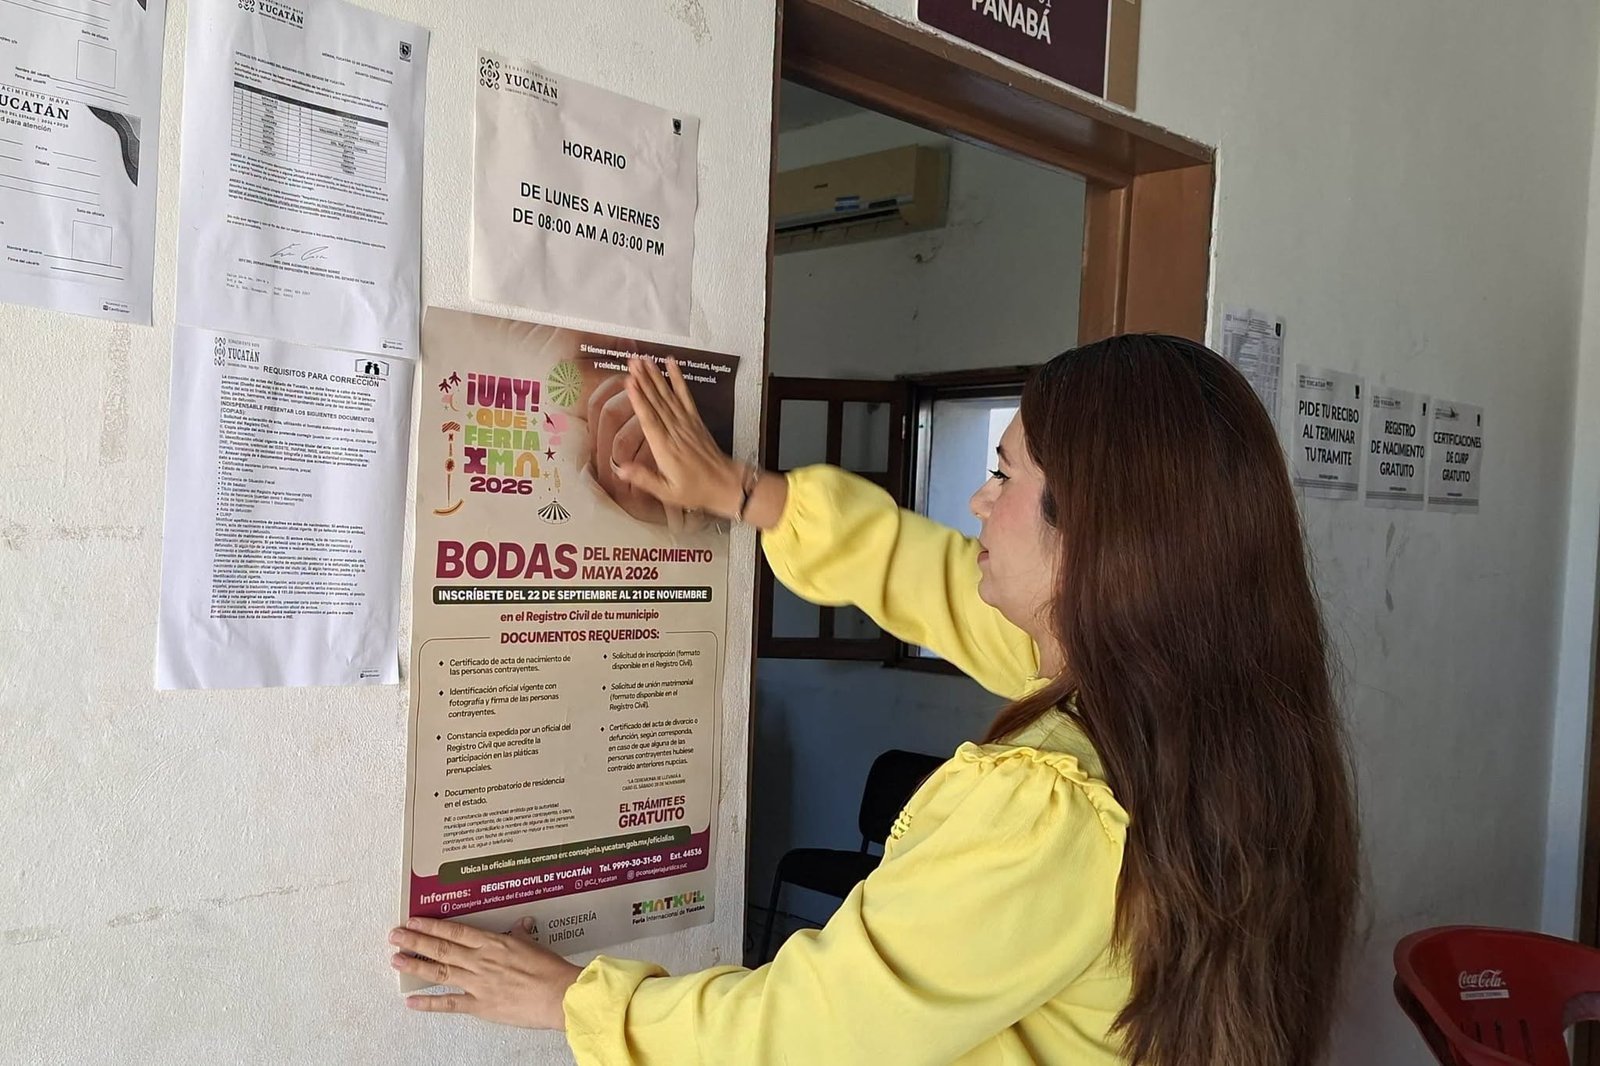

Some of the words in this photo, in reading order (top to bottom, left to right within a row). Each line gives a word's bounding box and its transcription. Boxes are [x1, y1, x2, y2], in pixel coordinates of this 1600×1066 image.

[259, 2, 303, 24] YUCATÁN
[505, 73, 557, 99] YUCATÁN
[562, 140, 626, 170] HORARIO
[521, 182, 541, 200] DE
[545, 188, 589, 212] LUNES
[594, 202, 603, 216] A
[607, 204, 660, 230] VIERNES
[513, 207, 533, 226] DE
[538, 214, 571, 234] 08:00
[575, 223, 596, 240] AM
[600, 228, 609, 243] A
[612, 231, 642, 251] 03:00
[646, 240, 664, 256] PM
[228, 347, 260, 362] YUCATÁN
[588, 345, 606, 354] tienes
[607, 349, 631, 358] mayoría
[599, 362, 620, 370] celebra
[263, 365, 306, 379] REQUISITOS
[308, 371, 328, 381] PARA
[330, 374, 380, 388] CORRECCIÓN
[466, 372, 540, 413] ¡UAY!
[221, 401, 263, 410] INDISPENSABLE
[264, 405, 294, 414] PRESENTAR
[307, 411, 337, 419] SIGUIENTES
[338, 414, 375, 423] DOCUMENTOS
[1299, 400, 1320, 417] PIDE
[1322, 403, 1330, 418] TU
[1331, 406, 1359, 423] RECIBO
[1302, 424, 1314, 439] AL
[1316, 426, 1355, 444] TERMINAR
[1385, 420, 1416, 437] REGISTRO
[464, 425, 540, 451] FERIA
[1433, 432, 1481, 448] CERTIFICACIONES
[1305, 447, 1316, 462] TU
[1318, 448, 1352, 466] TRAMITE
[1371, 440, 1381, 454] DE
[1383, 441, 1424, 459] NACIMIENTO
[1446, 452, 1454, 463] DE
[1454, 452, 1469, 464] CURP
[1380, 462, 1414, 477] GRATUITO
[1442, 469, 1470, 482] GRATUITO
[470, 476, 533, 495] 2026
[436, 540, 577, 579] BODAS
[584, 547, 608, 561] DEL
[612, 548, 712, 562] RENACIMIENTO
[582, 566, 622, 579] MAYA
[625, 566, 658, 579] 2026
[439, 588, 503, 600] INSCRÍBETE
[505, 590, 524, 600] DEL
[527, 590, 539, 600] 22
[541, 590, 555, 599] DE
[557, 590, 617, 599] SEPTIEMBRE
[619, 590, 629, 599] AL
[632, 590, 641, 599] 21
[643, 590, 654, 599] DE
[656, 590, 707, 599] NOVIEMBRE
[500, 614, 513, 622] en
[515, 611, 524, 622] el
[525, 611, 567, 624] Registro
[568, 610, 590, 620] Civil
[590, 610, 602, 620] de
[604, 610, 614, 620] tu
[615, 610, 659, 622] municipio
[500, 631, 586, 643] DOCUMENTOS
[588, 630, 660, 641] REQUERIDOS:
[450, 657, 489, 667] Certificado
[490, 657, 499, 665] de
[500, 656, 515, 664] acta
[525, 655, 562, 664] nacimiento
[612, 651, 637, 660] Solicitud
[645, 650, 675, 660] inscripción
[675, 649, 700, 659] (formato
[460, 668, 493, 677] personas
[494, 665, 539, 675] contrayentes.
[450, 685, 497, 695] Identificación
[498, 684, 518, 693] oficial
[519, 683, 544, 693] vigente
[449, 697, 484, 709] fotografía
[490, 696, 509, 704] firma
[529, 695, 559, 703] personas
[448, 708, 496, 719] contrayentes.
[447, 730, 487, 740] Constancia
[488, 727, 518, 739] expedida
[519, 728, 530, 736] por
[541, 724, 560, 733] oficial
[561, 723, 571, 731] del
[446, 764, 492, 776] prenupciales.
[620, 802, 631, 813] EL
[632, 798, 672, 811] TRÁMITE
[673, 796, 685, 806] ES
[618, 808, 684, 828] GRATUITO
[461, 865, 481, 874] Ubica
[516, 857, 530, 866] más
[531, 854, 557, 863] cercana
[481, 879, 521, 893] REGISTRO
[522, 875, 542, 886] CIVIL
[543, 873, 554, 883] DE
[556, 866, 591, 881] YUCATÁN
[600, 863, 610, 873] Tel.
[612, 855, 662, 871] 9999-30-31-50
[670, 852, 680, 861] Ext.
[682, 848, 702, 859] 44536
[420, 889, 471, 904] Informes:
[452, 899, 481, 912] Consejería
[483, 895, 504, 905] Jurídica
[514, 890, 534, 899] Estado
[542, 884, 564, 894] Yucatán
[548, 910, 597, 929] CONSEJERÍA
[632, 916, 645, 924] Feria
[646, 910, 678, 922] Internacional
[685, 905, 704, 915] Yucatán
[550, 927, 585, 944] JURÍDICA
